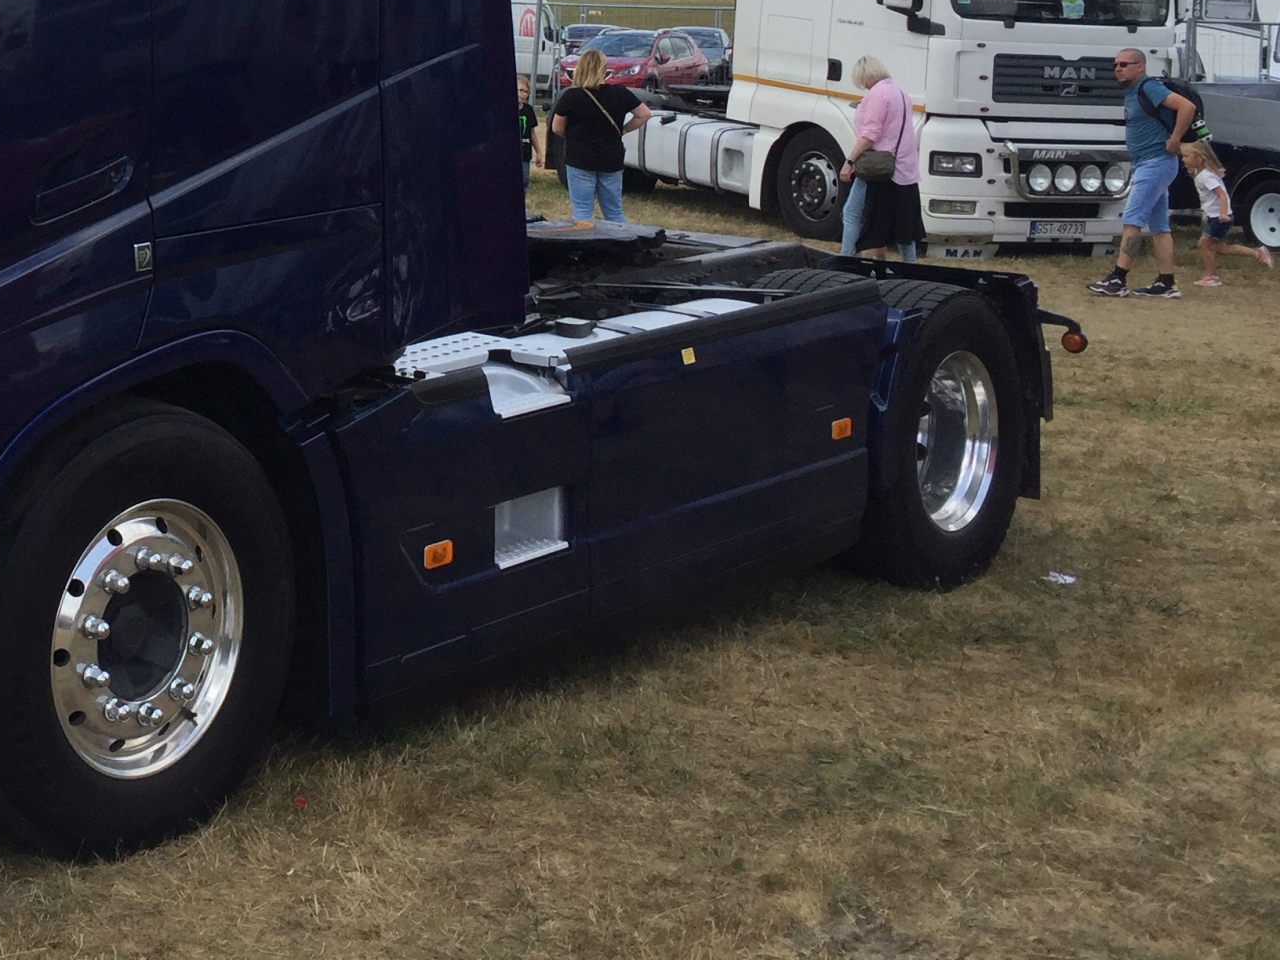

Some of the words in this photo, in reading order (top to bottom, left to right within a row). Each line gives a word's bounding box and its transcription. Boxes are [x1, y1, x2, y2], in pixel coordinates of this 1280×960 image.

[1044, 66, 1096, 80] MAN
[1032, 149, 1067, 159] MAN
[945, 248, 983, 258] MAN
